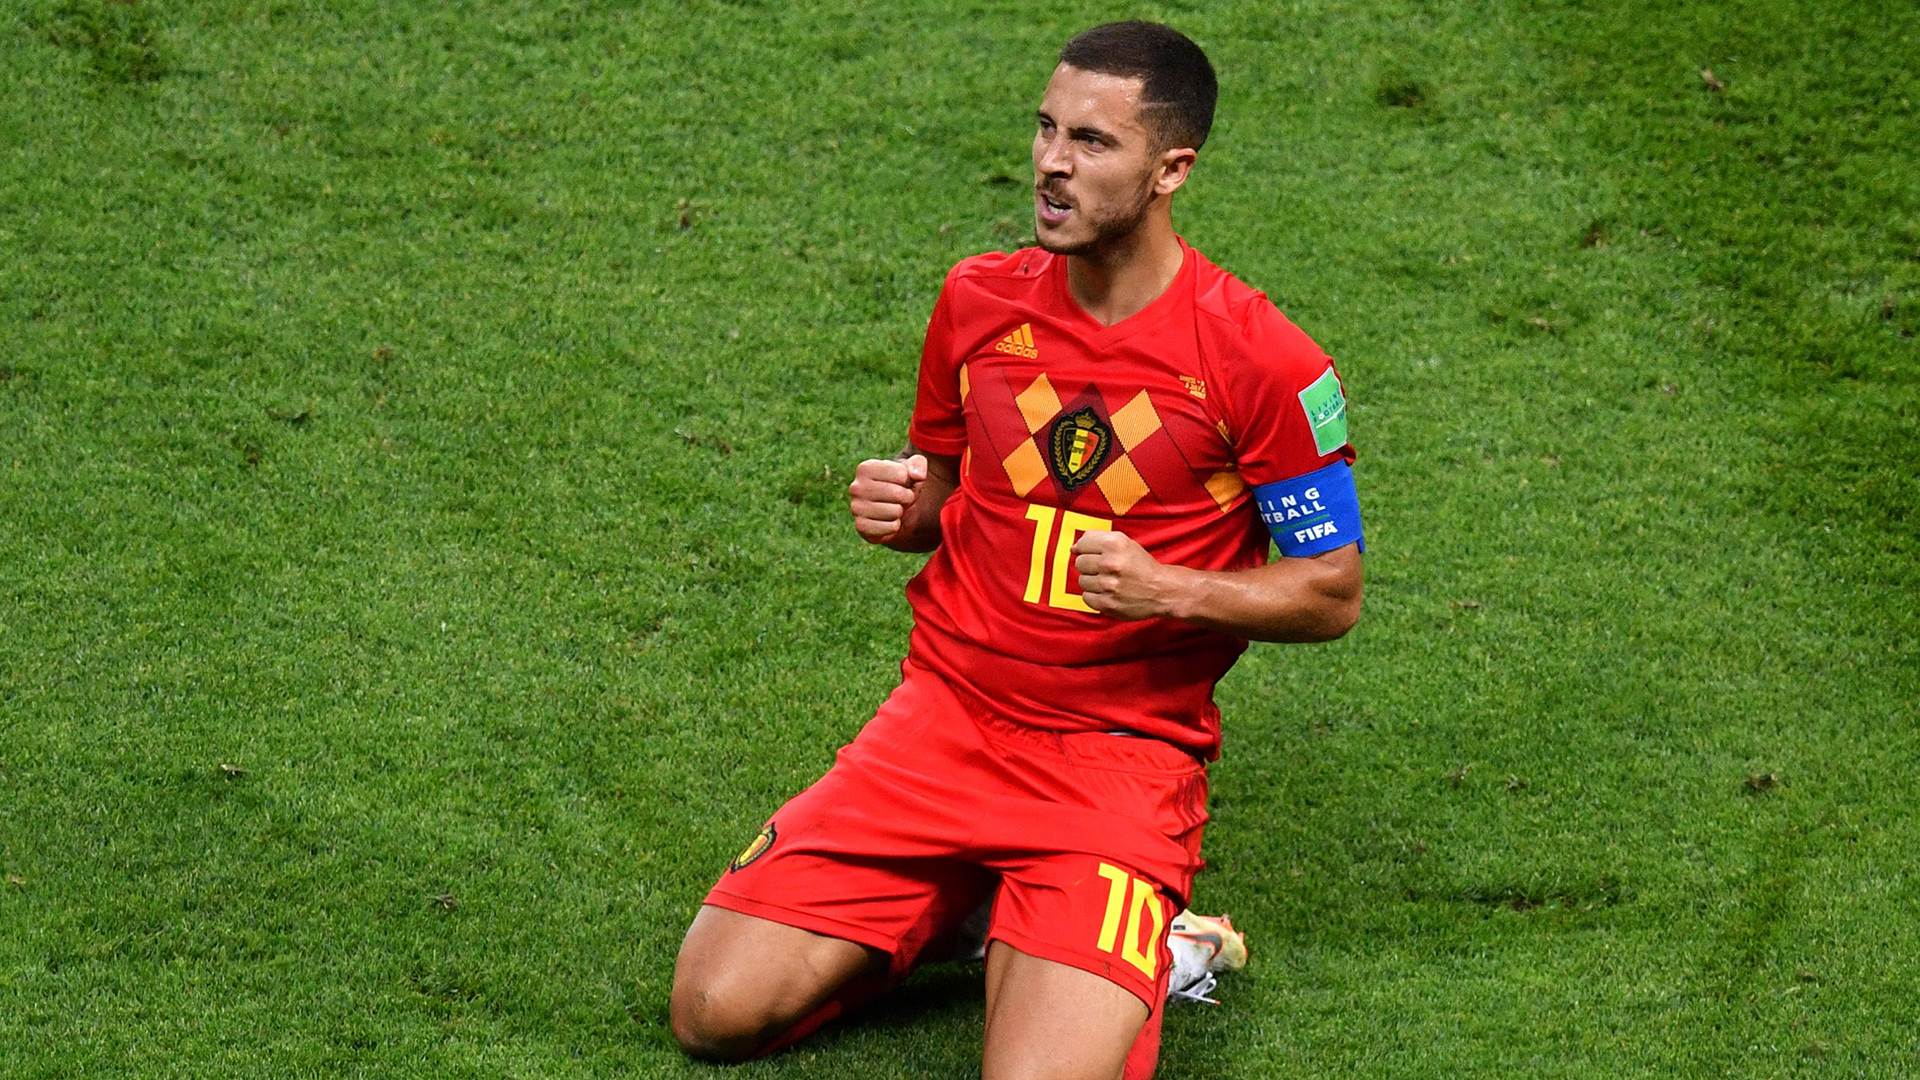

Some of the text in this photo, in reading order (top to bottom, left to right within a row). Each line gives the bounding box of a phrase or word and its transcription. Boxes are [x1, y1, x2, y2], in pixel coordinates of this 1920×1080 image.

[995, 342, 1038, 359] adidas
[1023, 503, 1113, 614] 10
[1294, 520, 1338, 543] FIFA
[1097, 862, 1163, 981] 10
